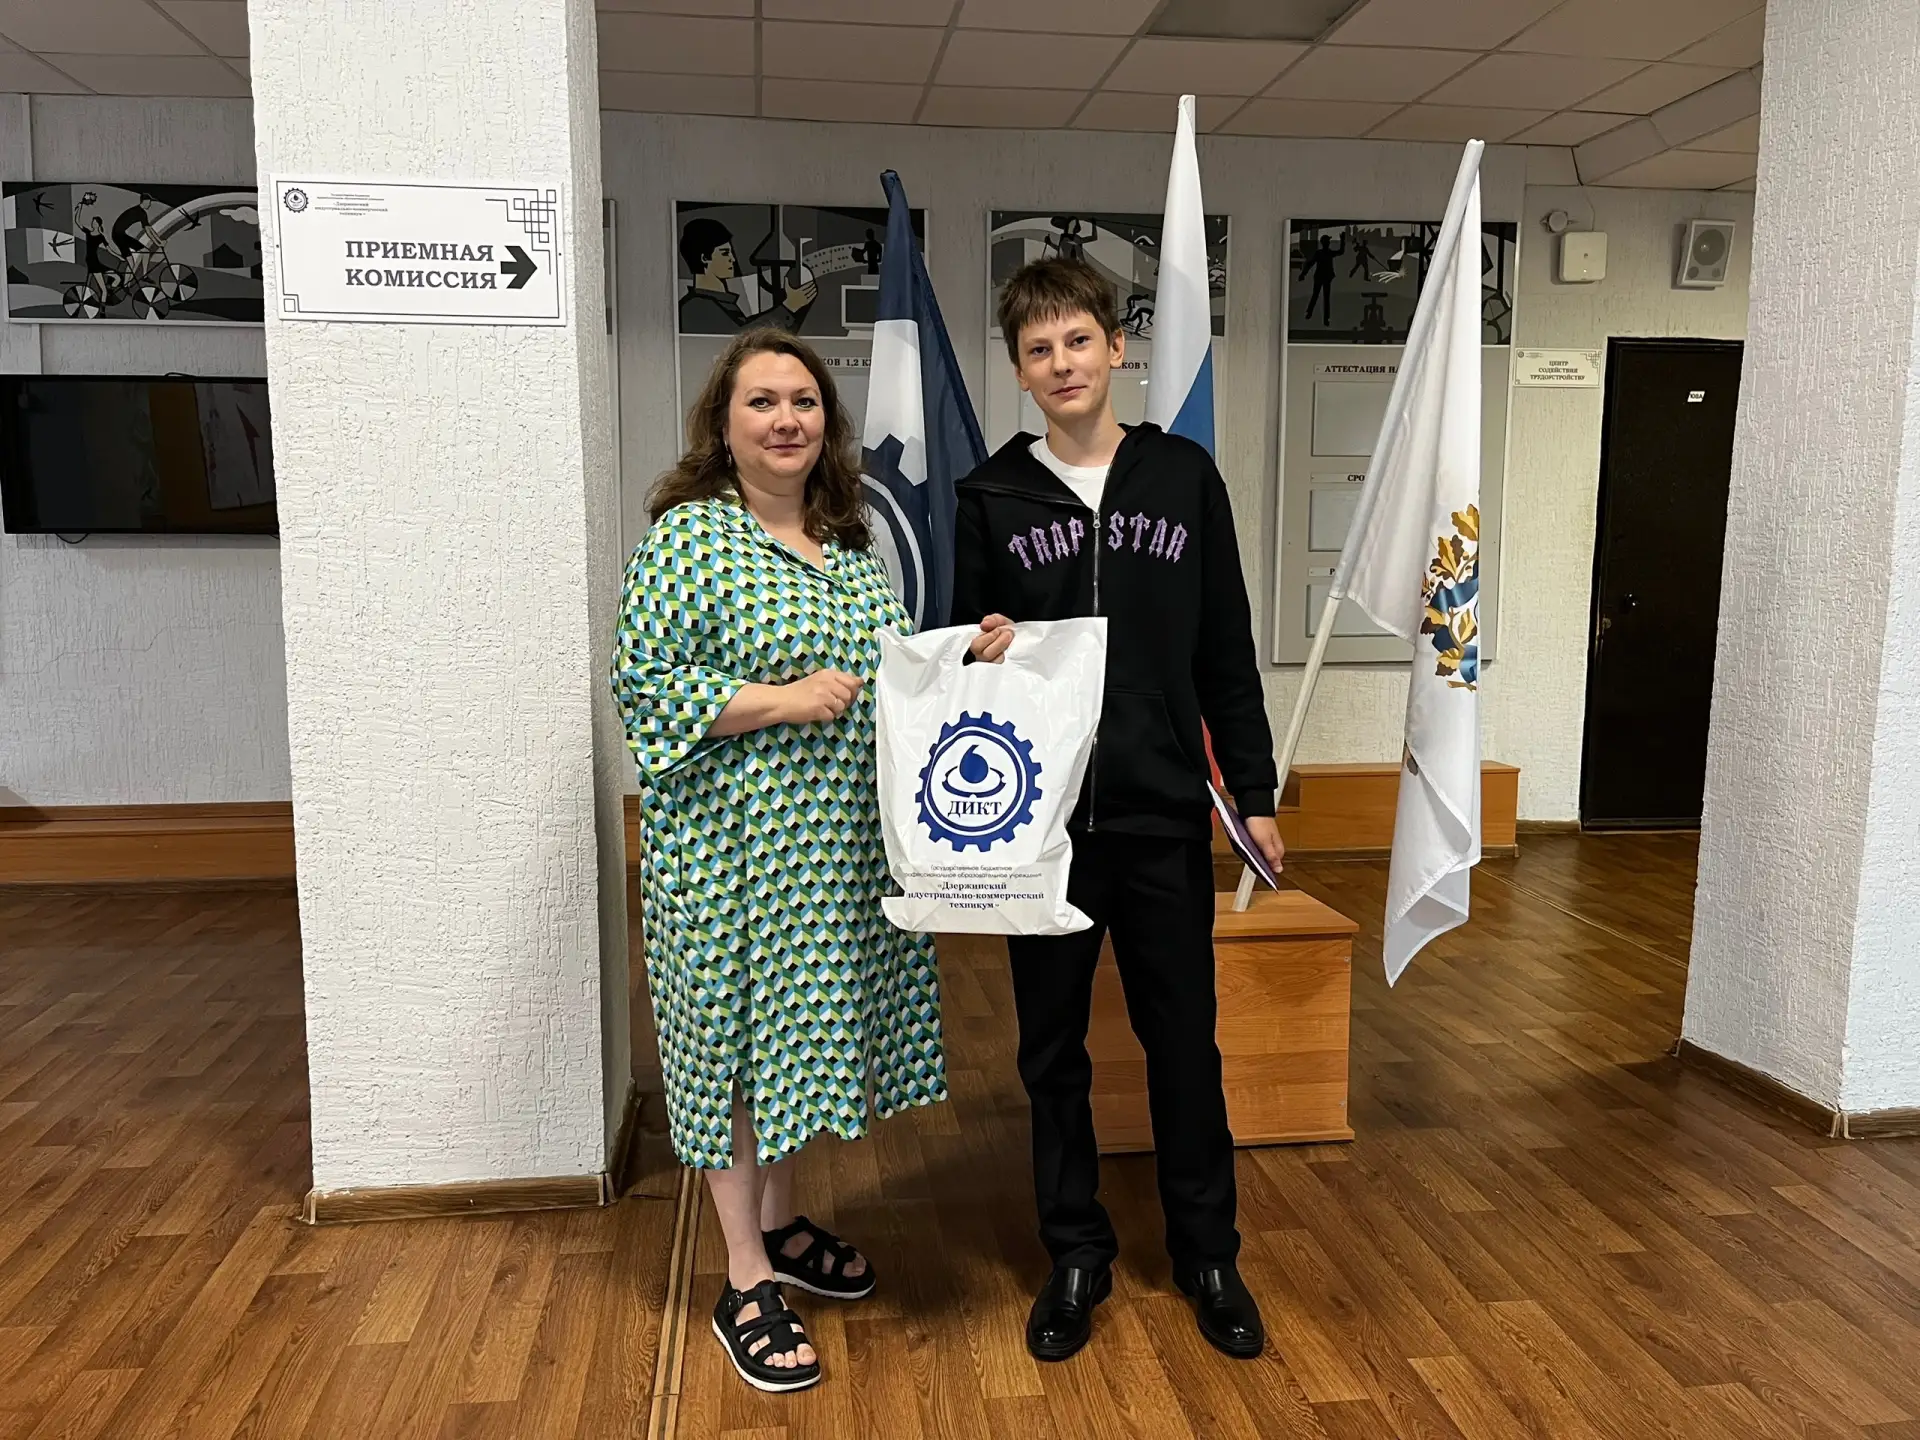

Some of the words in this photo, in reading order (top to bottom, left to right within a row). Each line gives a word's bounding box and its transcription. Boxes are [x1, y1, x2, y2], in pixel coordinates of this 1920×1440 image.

[345, 240, 494, 262] ПРИЕМНАЯ
[345, 268, 497, 289] КОМИССИЯ
[1121, 361, 1140, 370] КОВ
[1324, 365, 1386, 374] АТТЕСТАЦИЯ
[1347, 474, 1365, 482] СРО
[1007, 516, 1085, 571] TRAP
[1108, 510, 1188, 563] STAR
[947, 800, 1002, 818] ДИКТ
[908, 891, 1044, 901] ндустриально-коммерческий
